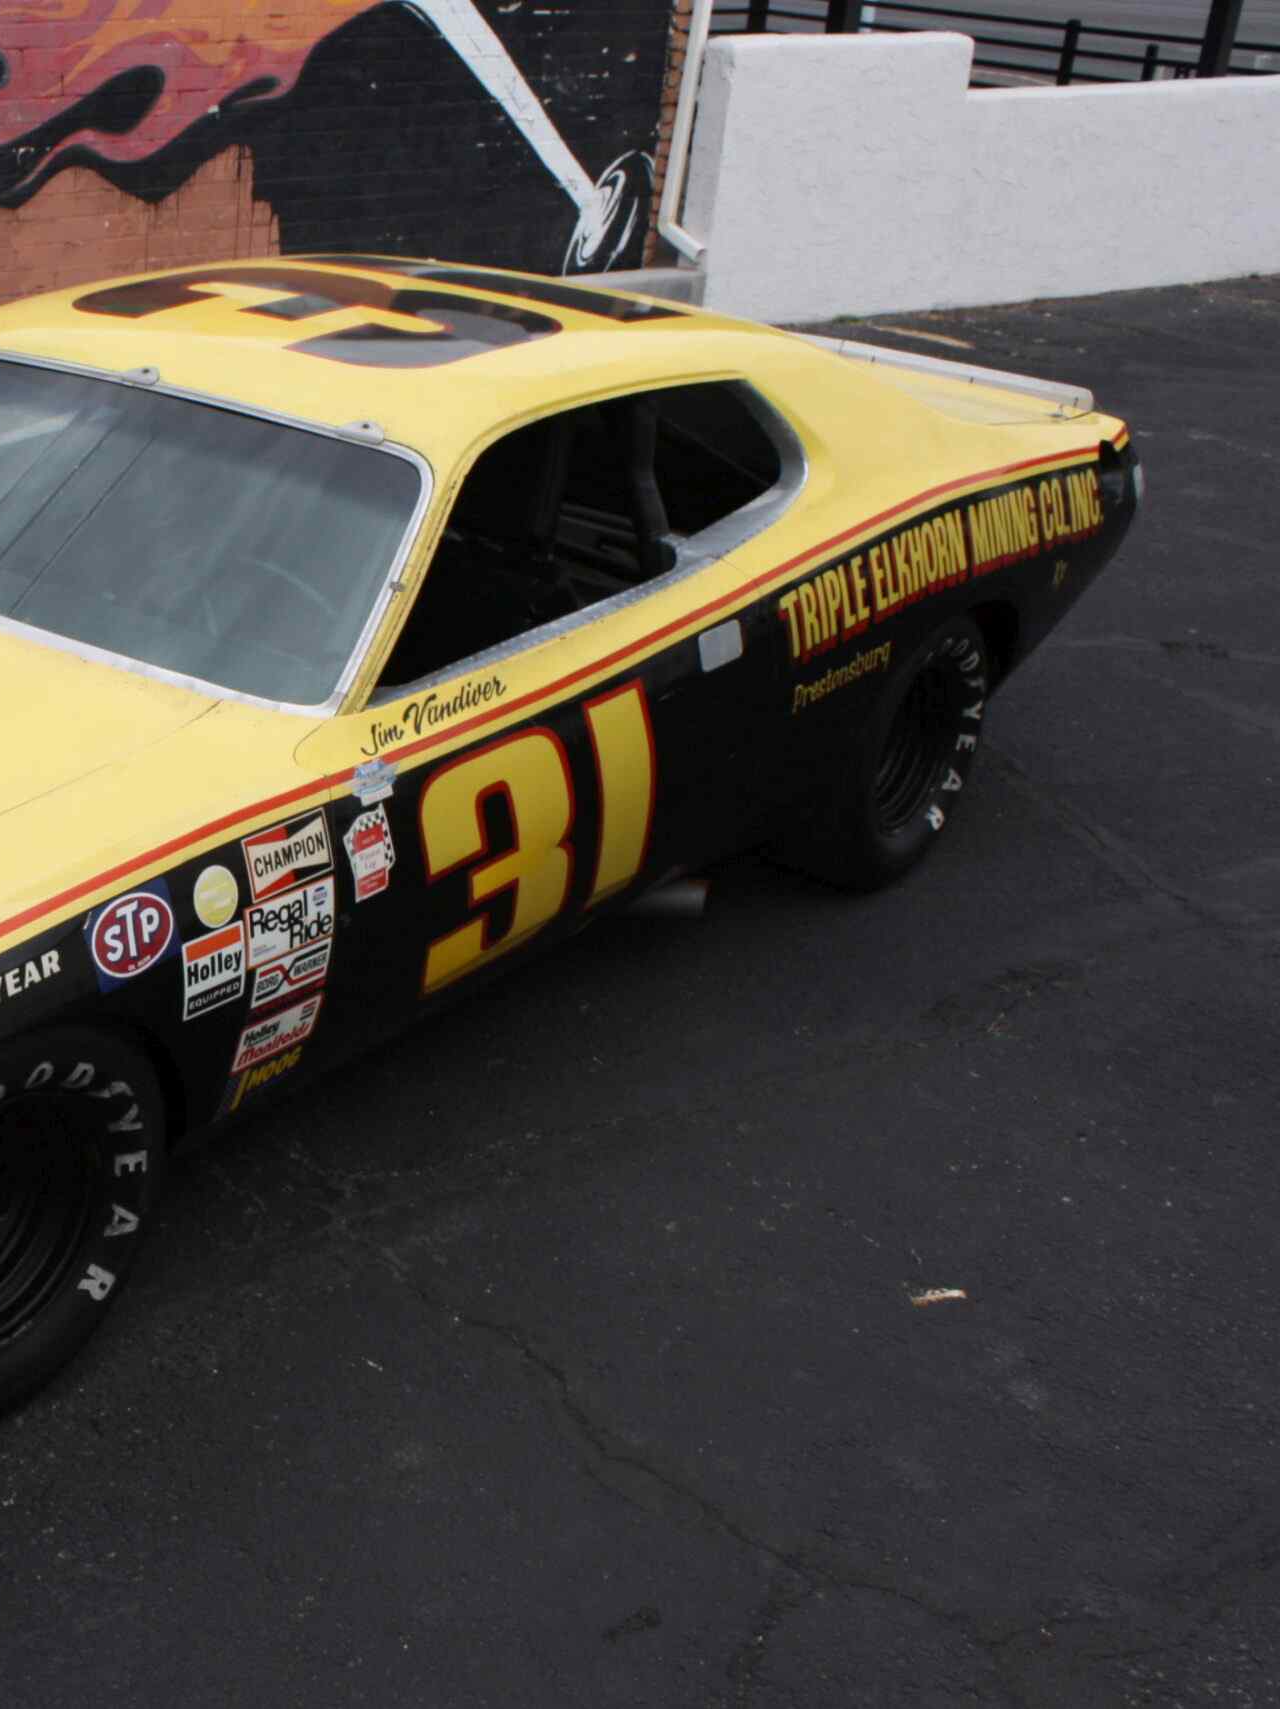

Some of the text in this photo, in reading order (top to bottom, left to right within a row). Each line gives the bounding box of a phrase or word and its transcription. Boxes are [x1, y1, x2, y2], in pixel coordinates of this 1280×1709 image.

[72, 255, 694, 369] 31
[780, 554, 871, 659] TRIPLE
[870, 508, 968, 612] ELKHORN
[969, 486, 1039, 567] MINING
[360, 675, 507, 757] Jim Vandiver
[253, 831, 326, 878] CHAMPION
[418, 677, 657, 998] 31
[103, 900, 161, 963] STP
[249, 889, 308, 939] Regal
[290, 911, 333, 949] Ride
[187, 949, 243, 988] Holley
[188, 981, 240, 1011] EQUIPPED
